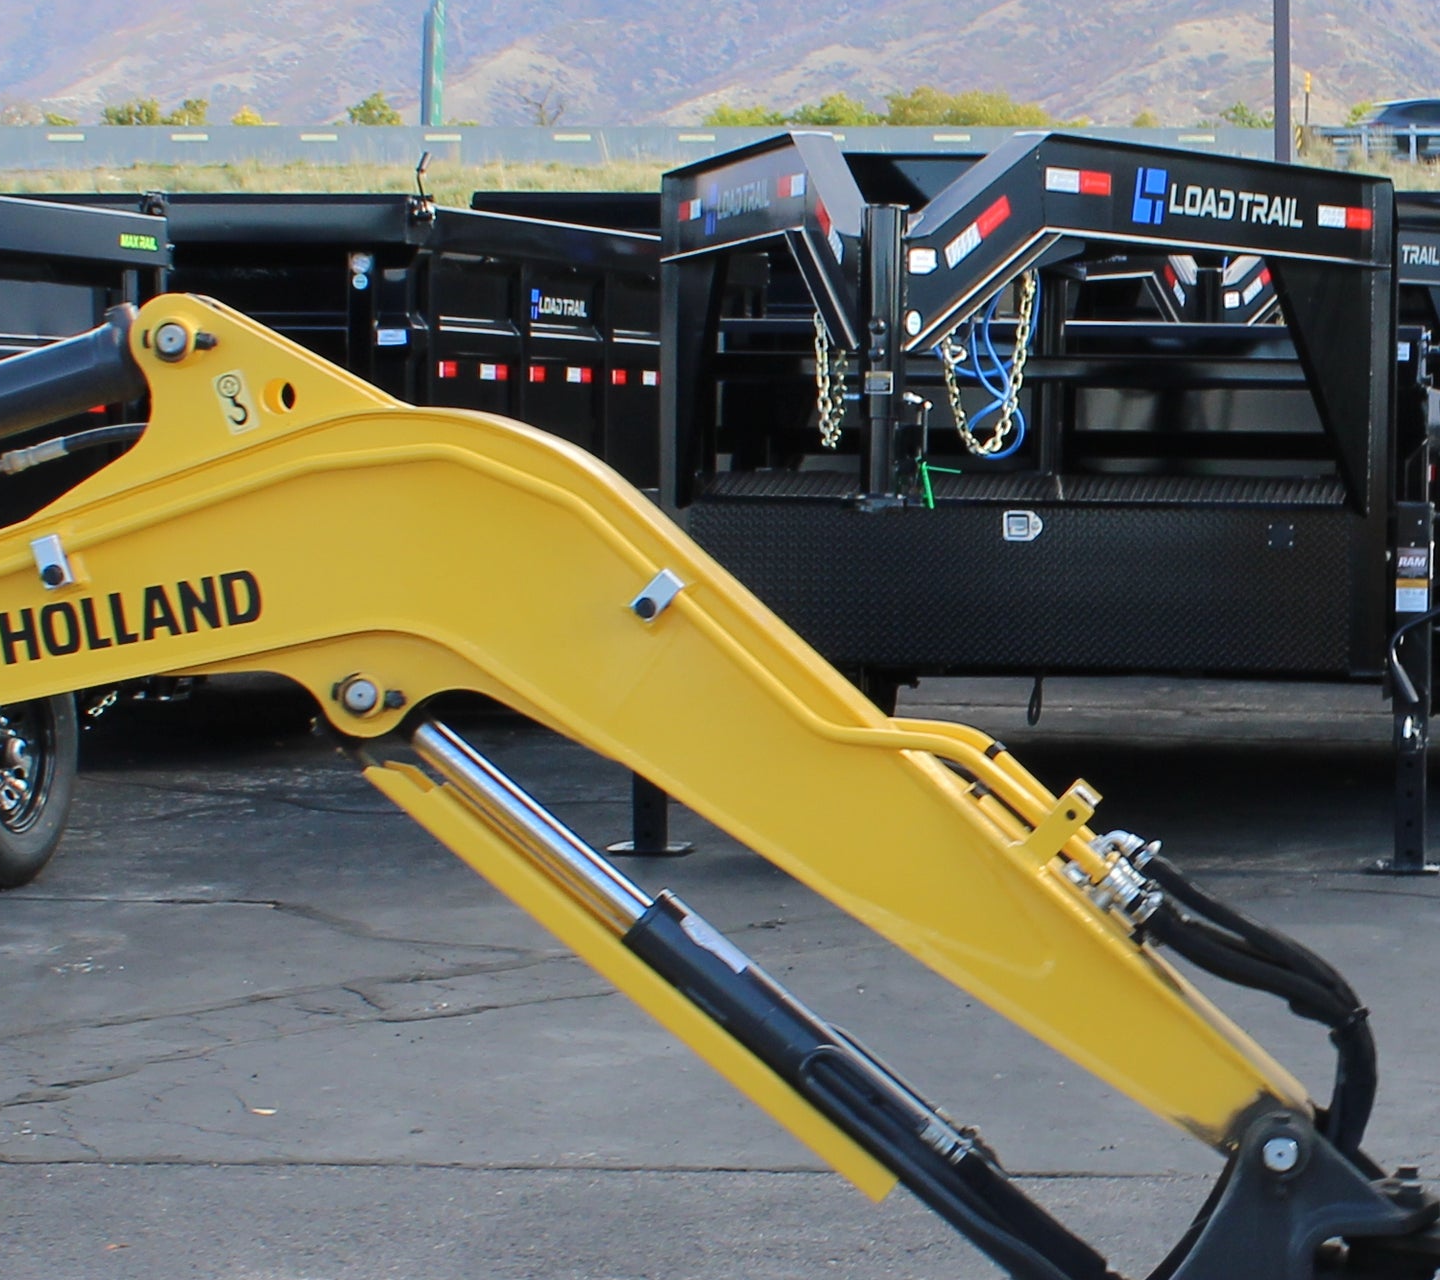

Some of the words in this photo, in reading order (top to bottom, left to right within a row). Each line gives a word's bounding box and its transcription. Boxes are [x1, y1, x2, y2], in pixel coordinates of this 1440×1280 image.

[1168, 183, 1236, 220] LOAD
[1238, 191, 1303, 228] TRAIL
[1402, 244, 1440, 266] TRAIL
[1398, 556, 1427, 568] RAM
